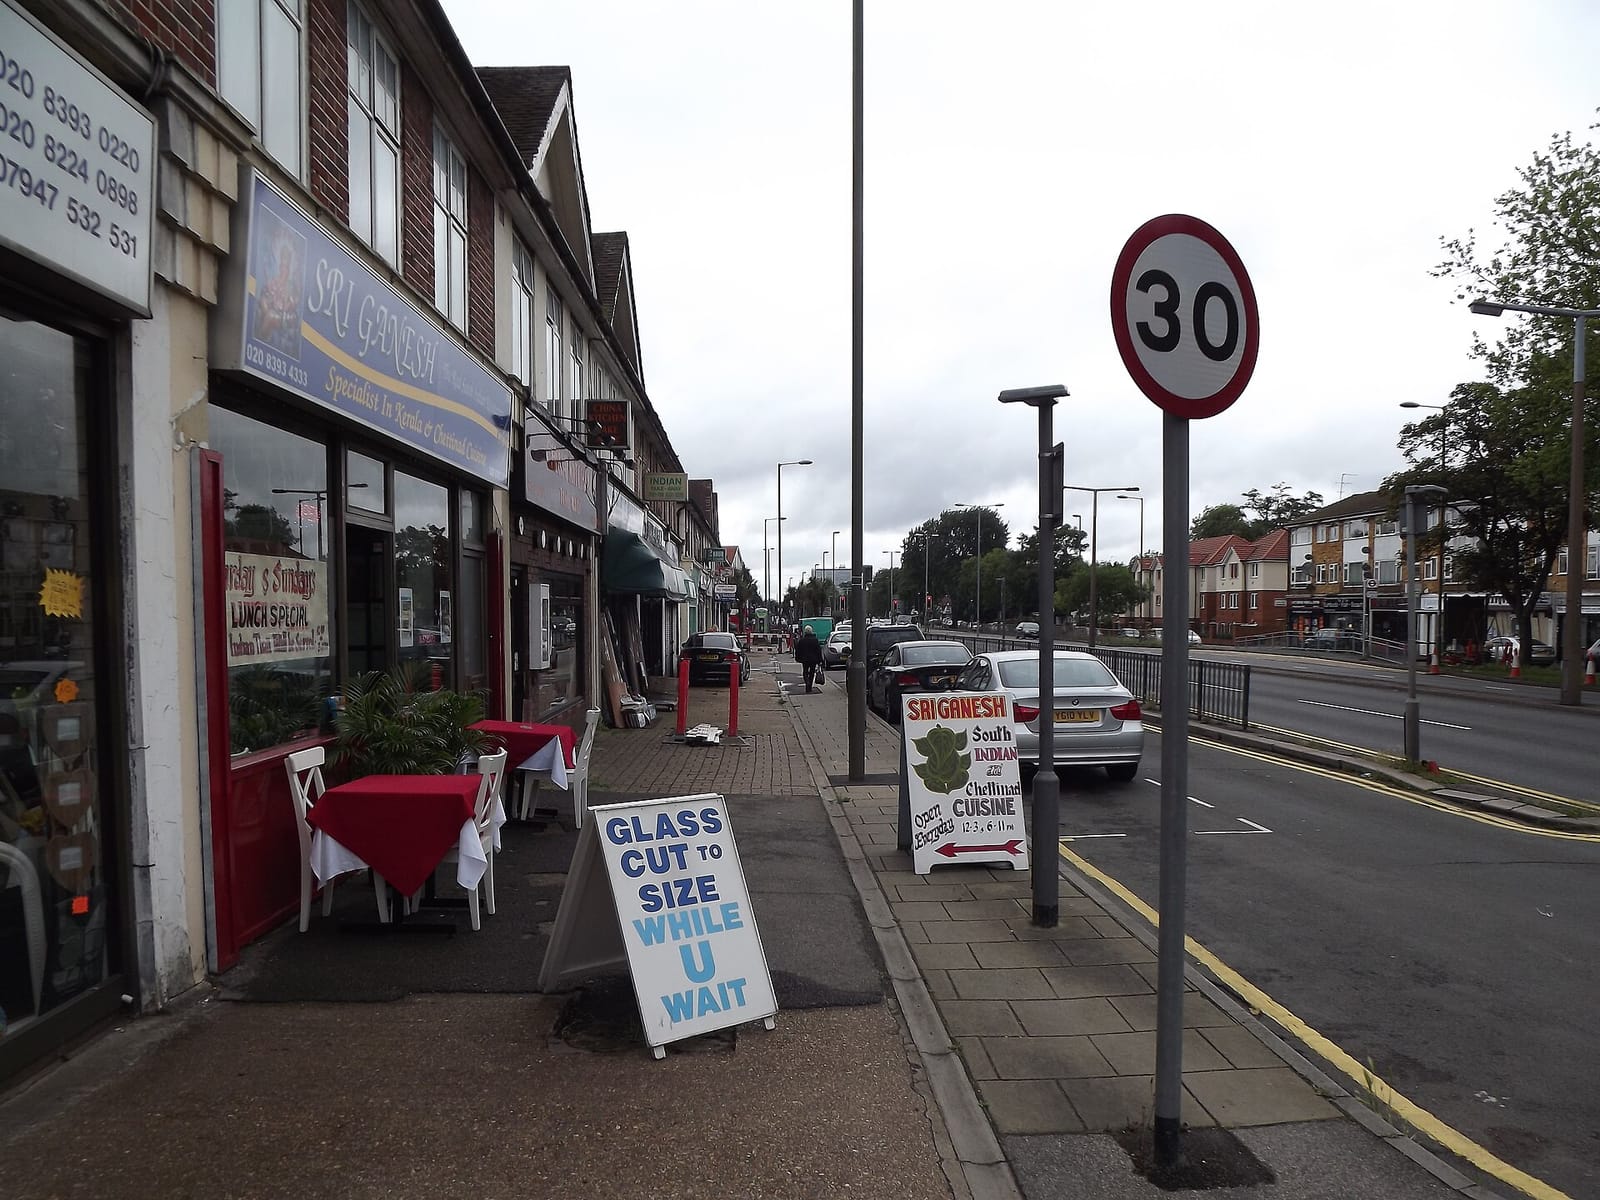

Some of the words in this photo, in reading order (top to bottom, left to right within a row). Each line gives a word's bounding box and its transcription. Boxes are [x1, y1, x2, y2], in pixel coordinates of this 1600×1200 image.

[43, 86, 91, 140] 8393
[99, 125, 140, 174] 0220
[0, 102, 35, 149] 020
[43, 133, 89, 184] 8224
[96, 169, 138, 216] 0898
[67, 196, 101, 239] 532
[109, 223, 137, 258] 531
[307, 257, 355, 339] SRI
[358, 295, 438, 385] GANESH
[1136, 269, 1239, 362] 30
[246, 344, 264, 367] 020
[265, 353, 287, 377] 8393
[288, 365, 308, 387] 4333
[325, 366, 379, 412] Specialist
[381, 394, 393, 417] In
[394, 402, 423, 434] Kerala
[424, 422, 434, 439] &
[650, 477, 682, 485] INDIAN
[231, 602, 267, 628] LUNCH
[270, 604, 309, 629] SPECIAL
[972, 724, 1012, 742] South
[975, 746, 1018, 762] INDIAN
[952, 798, 1016, 817] CUISINE
[966, 781, 1021, 797] Chettinad
[606, 807, 723, 846] GLASS
[915, 803, 942, 829] Open
[915, 817, 955, 850] Everyday
[620, 843, 689, 879] CUT
[696, 843, 723, 861] TO
[638, 875, 720, 913] SIZE
[632, 901, 744, 947] WHILE
[679, 939, 716, 984] U
[661, 977, 747, 1024] WAIT
